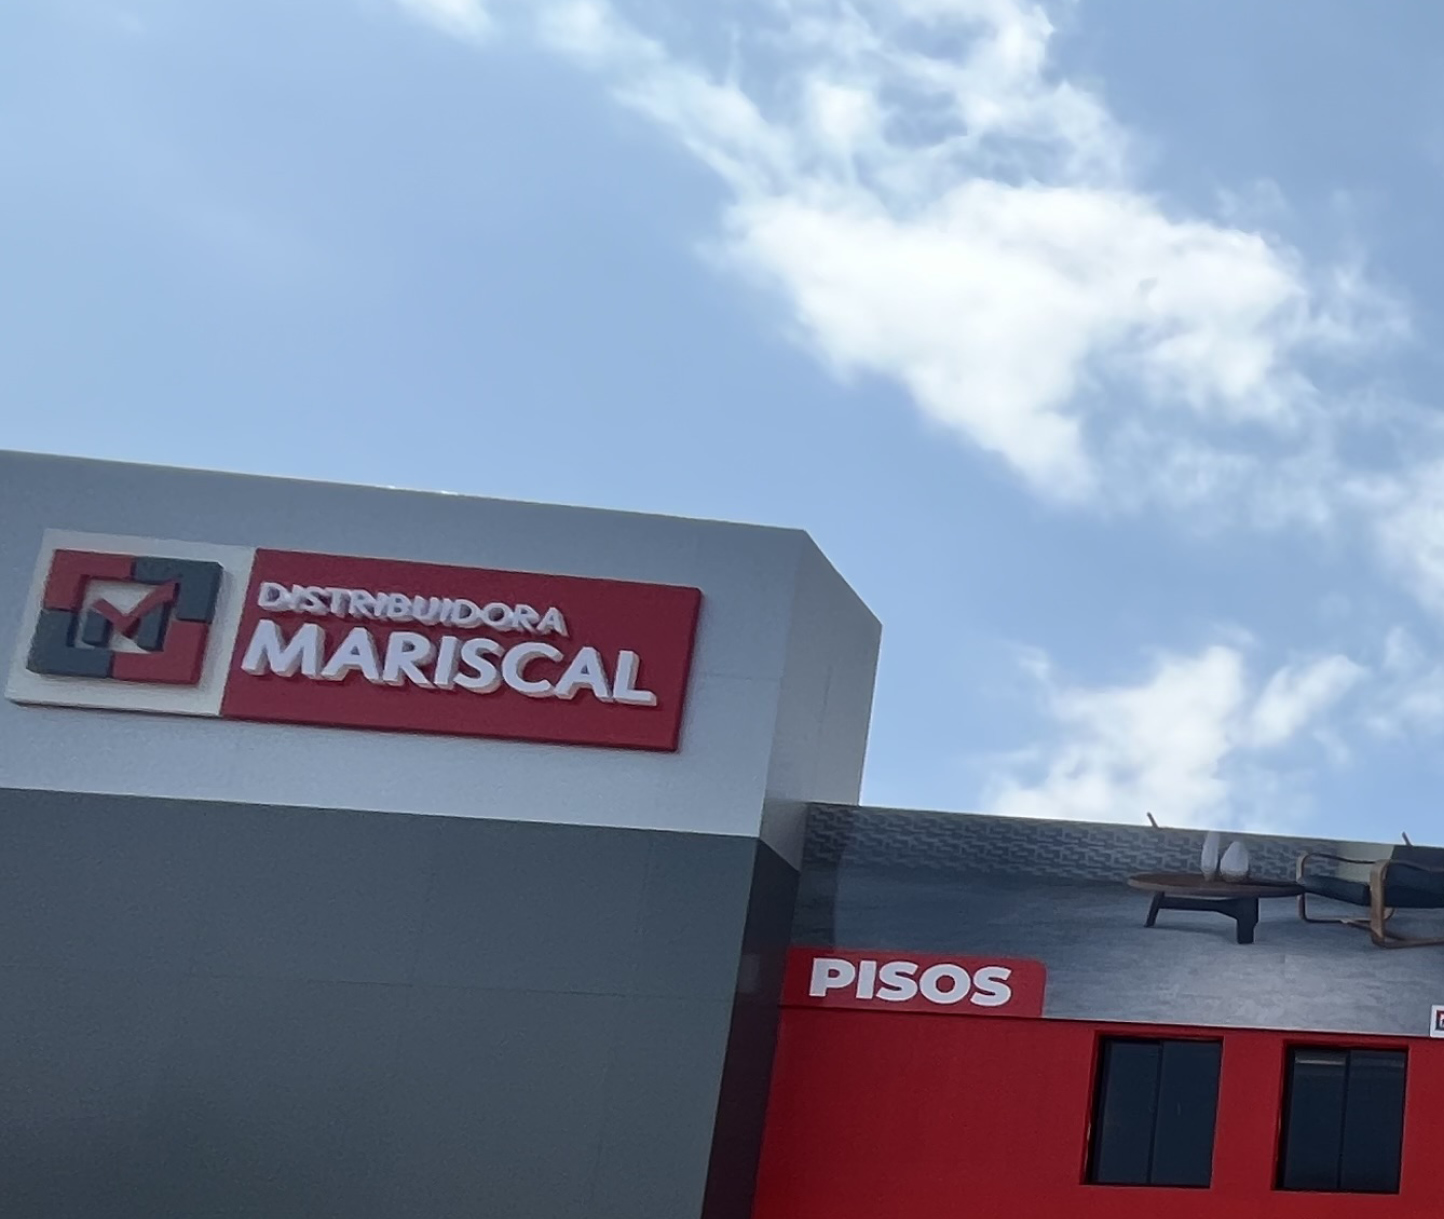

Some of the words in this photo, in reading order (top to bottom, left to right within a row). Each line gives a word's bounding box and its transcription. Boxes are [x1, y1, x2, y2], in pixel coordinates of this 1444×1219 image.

[257, 581, 569, 638] DISTRIBUIDORA
[242, 618, 658, 706] MARISCAL
[809, 957, 1012, 1007] PISOS
